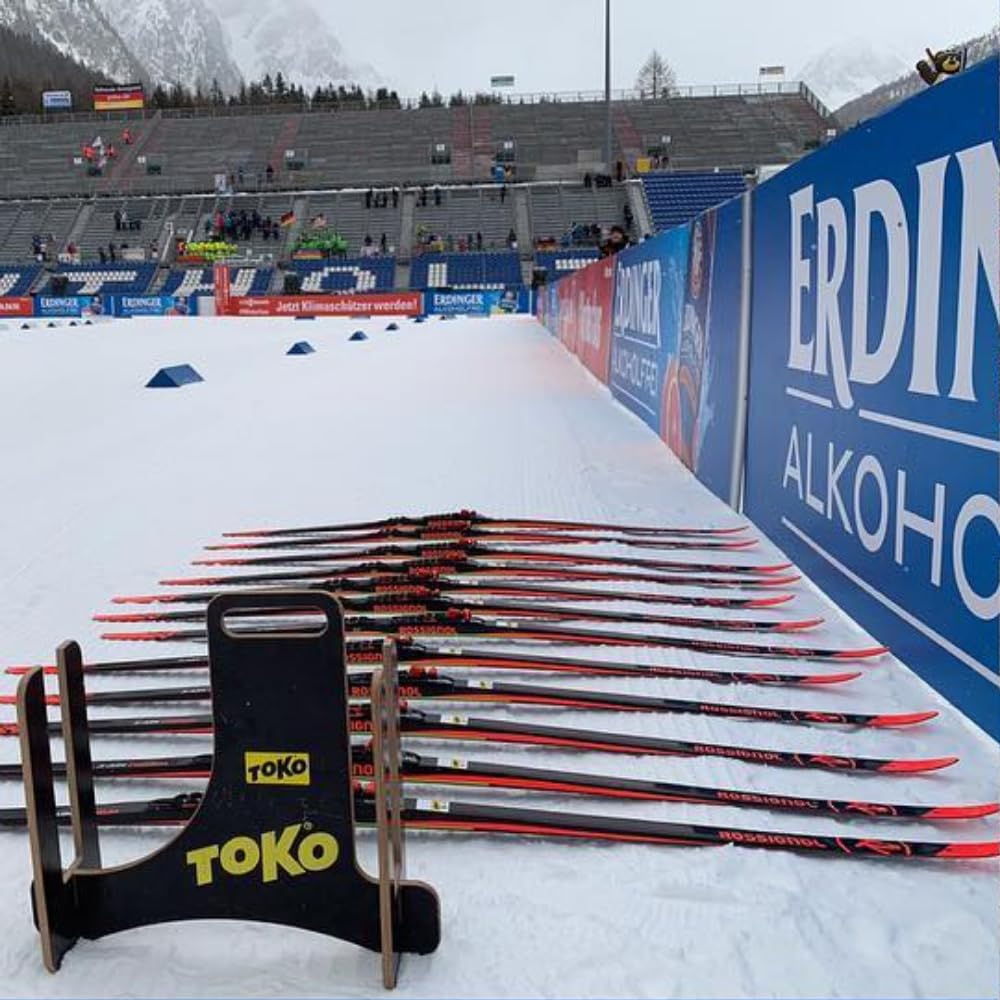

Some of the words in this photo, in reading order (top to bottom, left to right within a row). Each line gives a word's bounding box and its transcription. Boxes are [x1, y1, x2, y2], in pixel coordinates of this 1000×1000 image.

[782, 424, 1000, 620] ALKOHO
[248, 756, 307, 782] TOKO
[186, 823, 339, 886] TOKO
